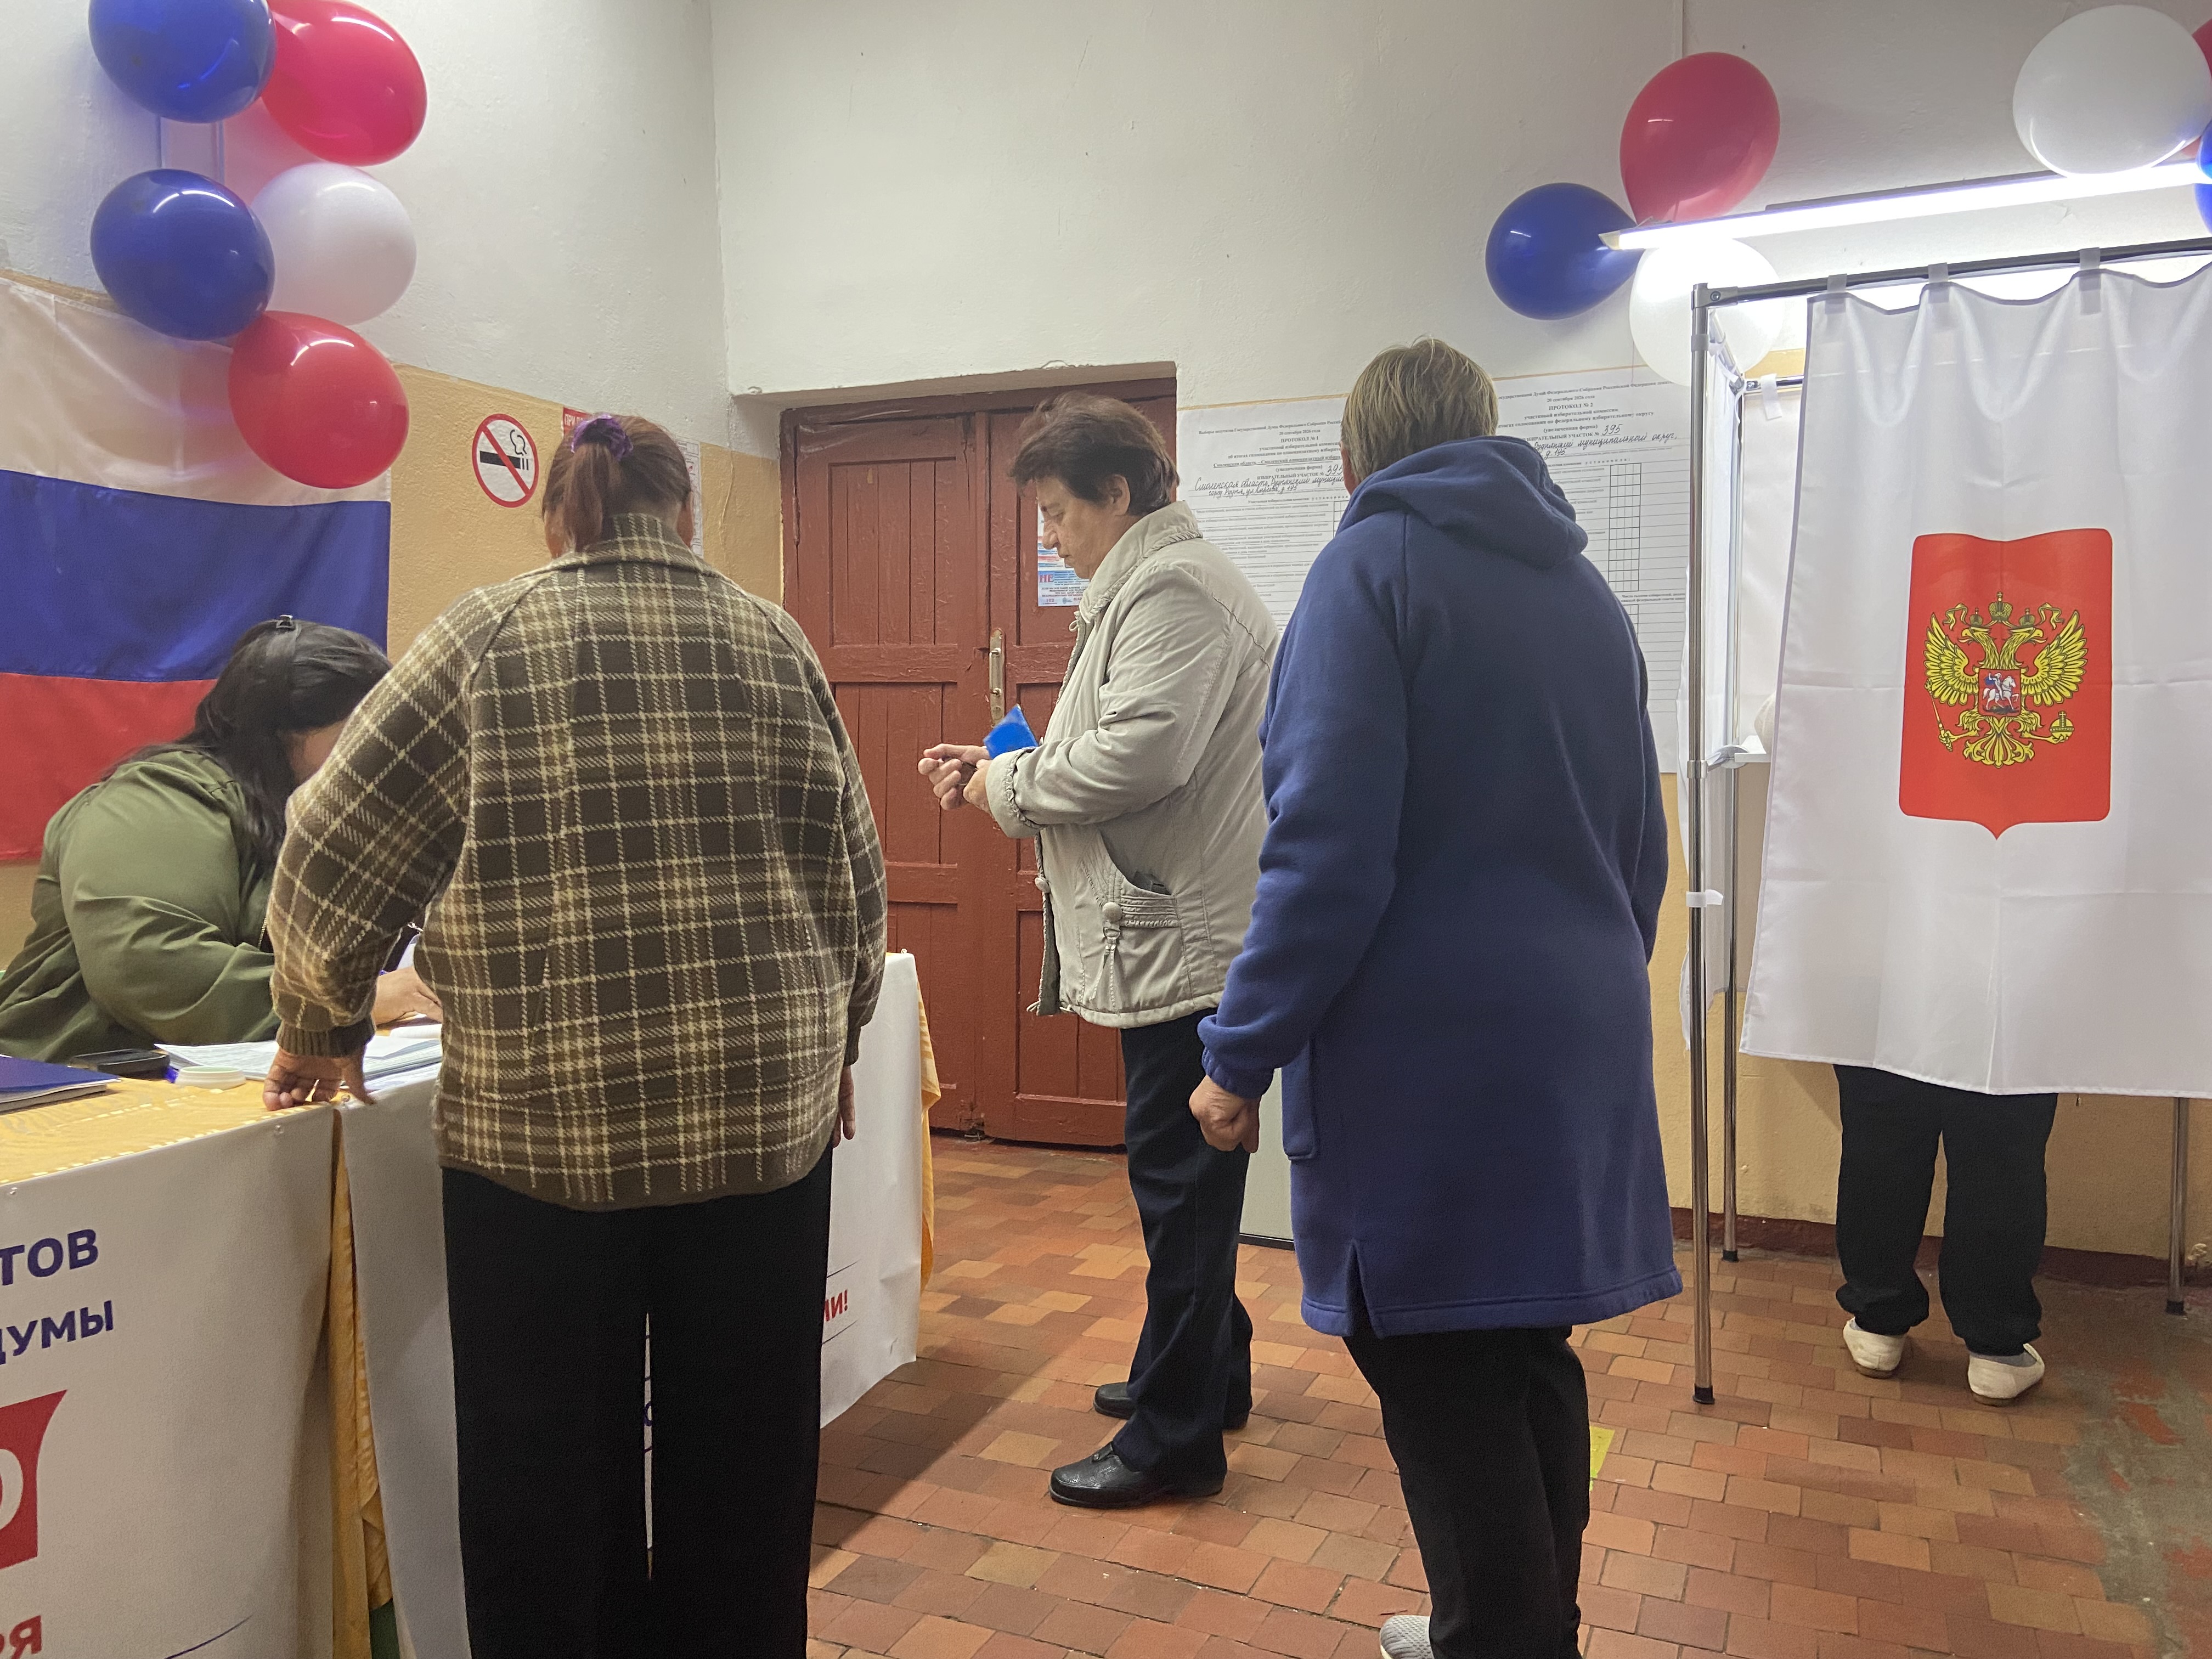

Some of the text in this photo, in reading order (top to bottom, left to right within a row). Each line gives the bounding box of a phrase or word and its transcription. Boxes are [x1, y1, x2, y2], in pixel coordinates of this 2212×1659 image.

[1602, 424, 1623, 436] 395
[1195, 477, 1239, 491] Смоленская
[1325, 464, 1343, 476] 395
[0, 1229, 99, 1286] ТОВ
[0, 1300, 114, 1365] УМЫ
[0, 1615, 42, 1659] Я
